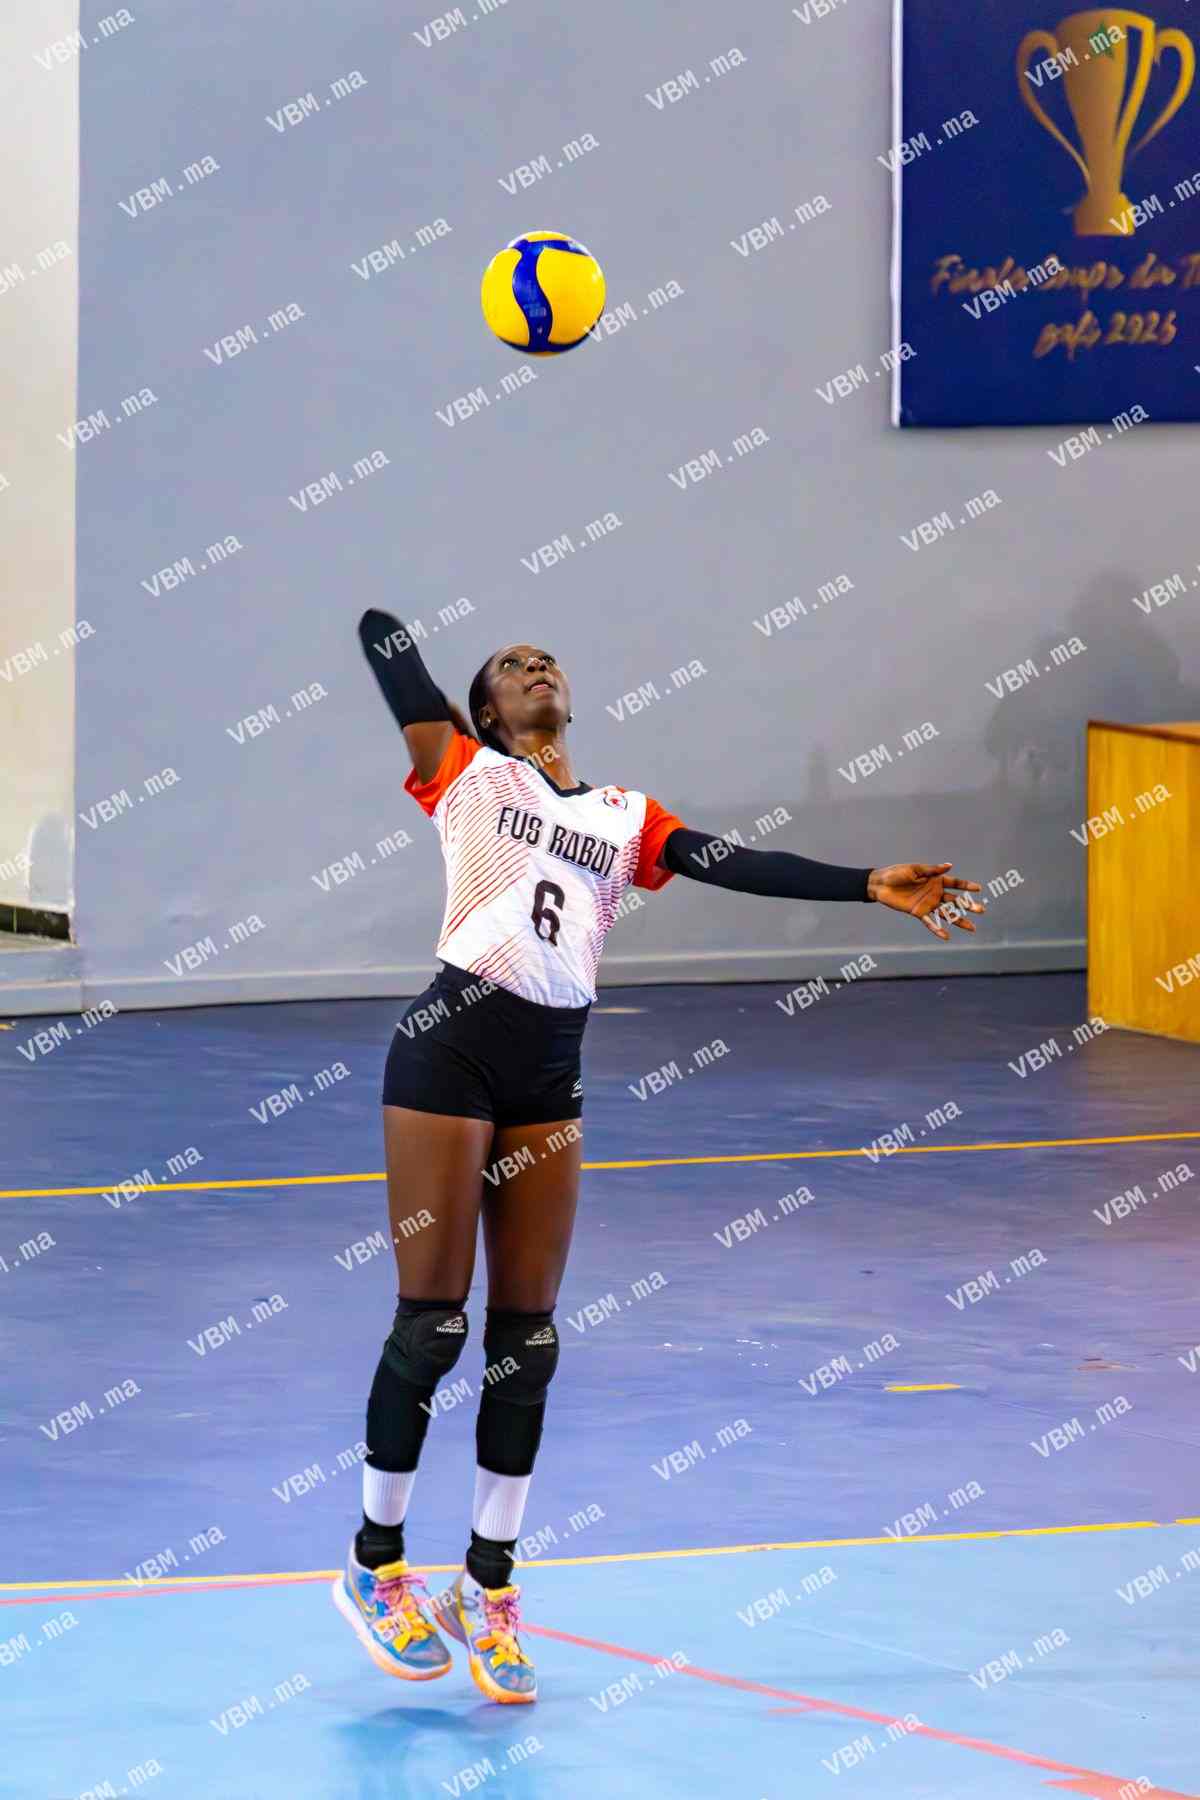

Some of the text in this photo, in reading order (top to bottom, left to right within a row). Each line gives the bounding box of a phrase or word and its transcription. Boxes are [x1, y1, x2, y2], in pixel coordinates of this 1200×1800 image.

[496, 805, 619, 878] FUS RABAT
[530, 879, 566, 947] 6
